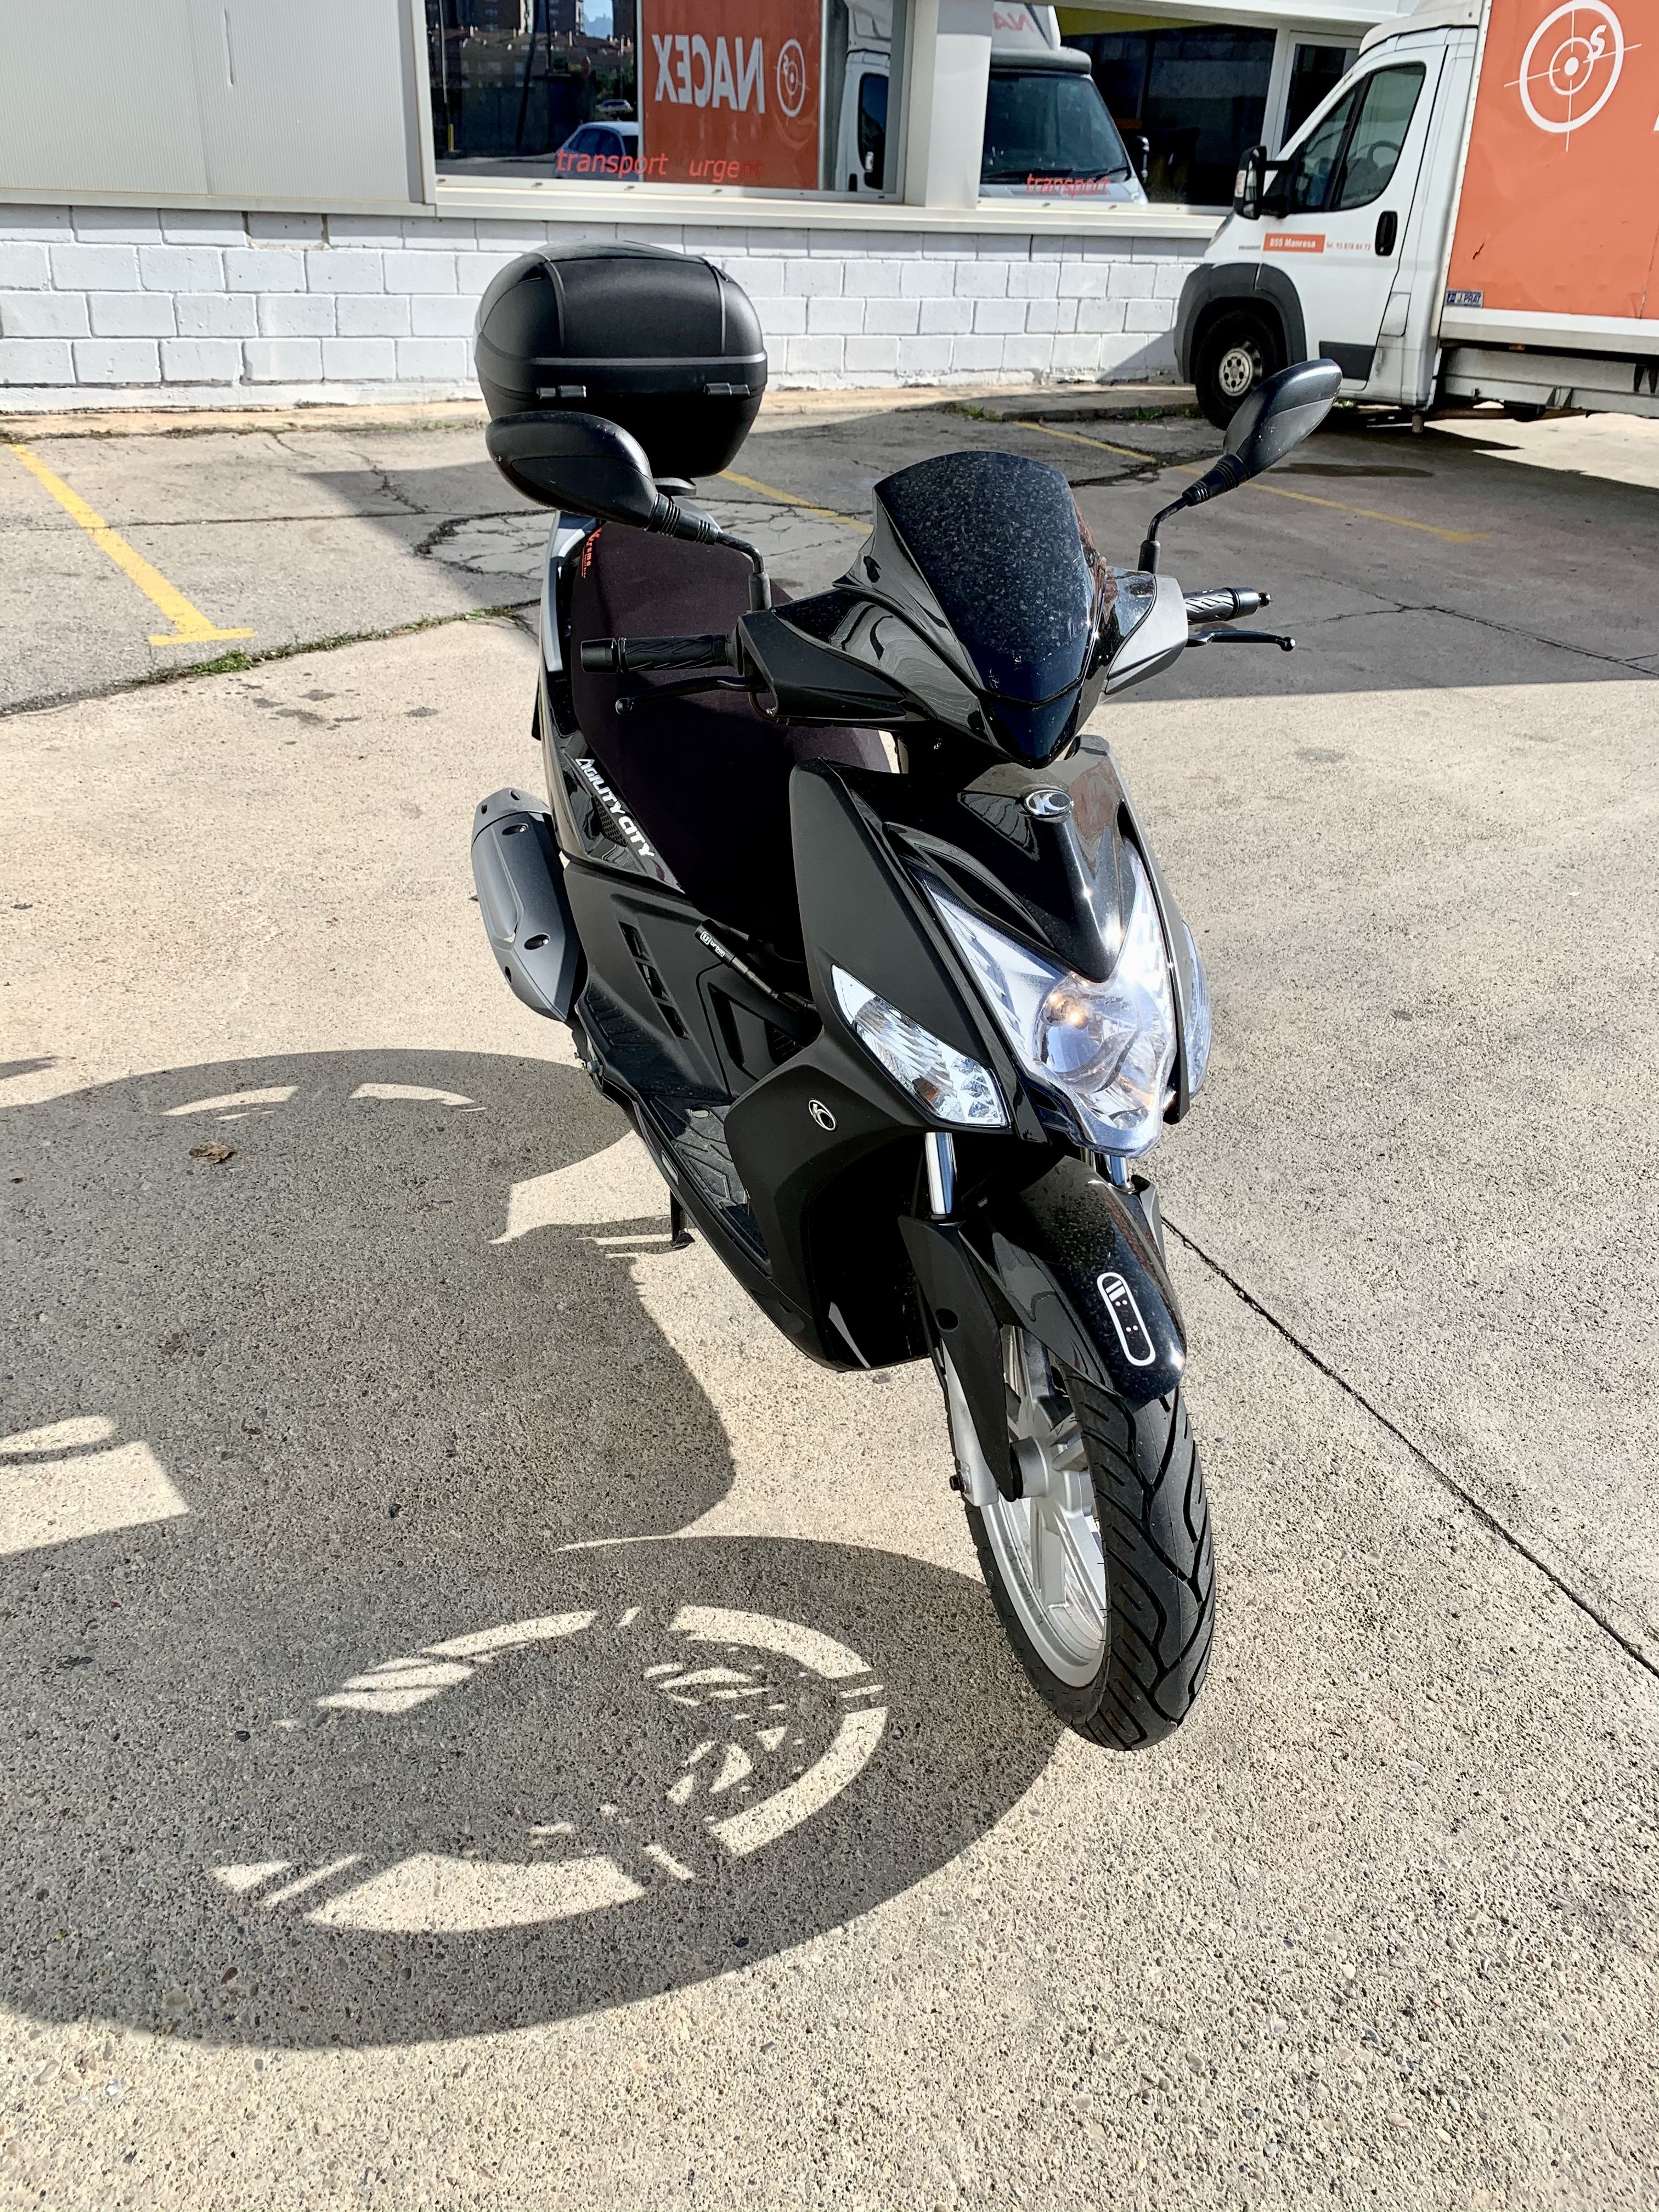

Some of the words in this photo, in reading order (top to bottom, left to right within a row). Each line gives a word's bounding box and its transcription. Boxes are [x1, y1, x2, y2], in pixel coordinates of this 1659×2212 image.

[556, 149, 669, 179] transport
[1026, 172, 1110, 199] transport
[1284, 238, 1316, 249] Manresa
[575, 758, 626, 814] AGILITY
[618, 816, 655, 857] CITY
